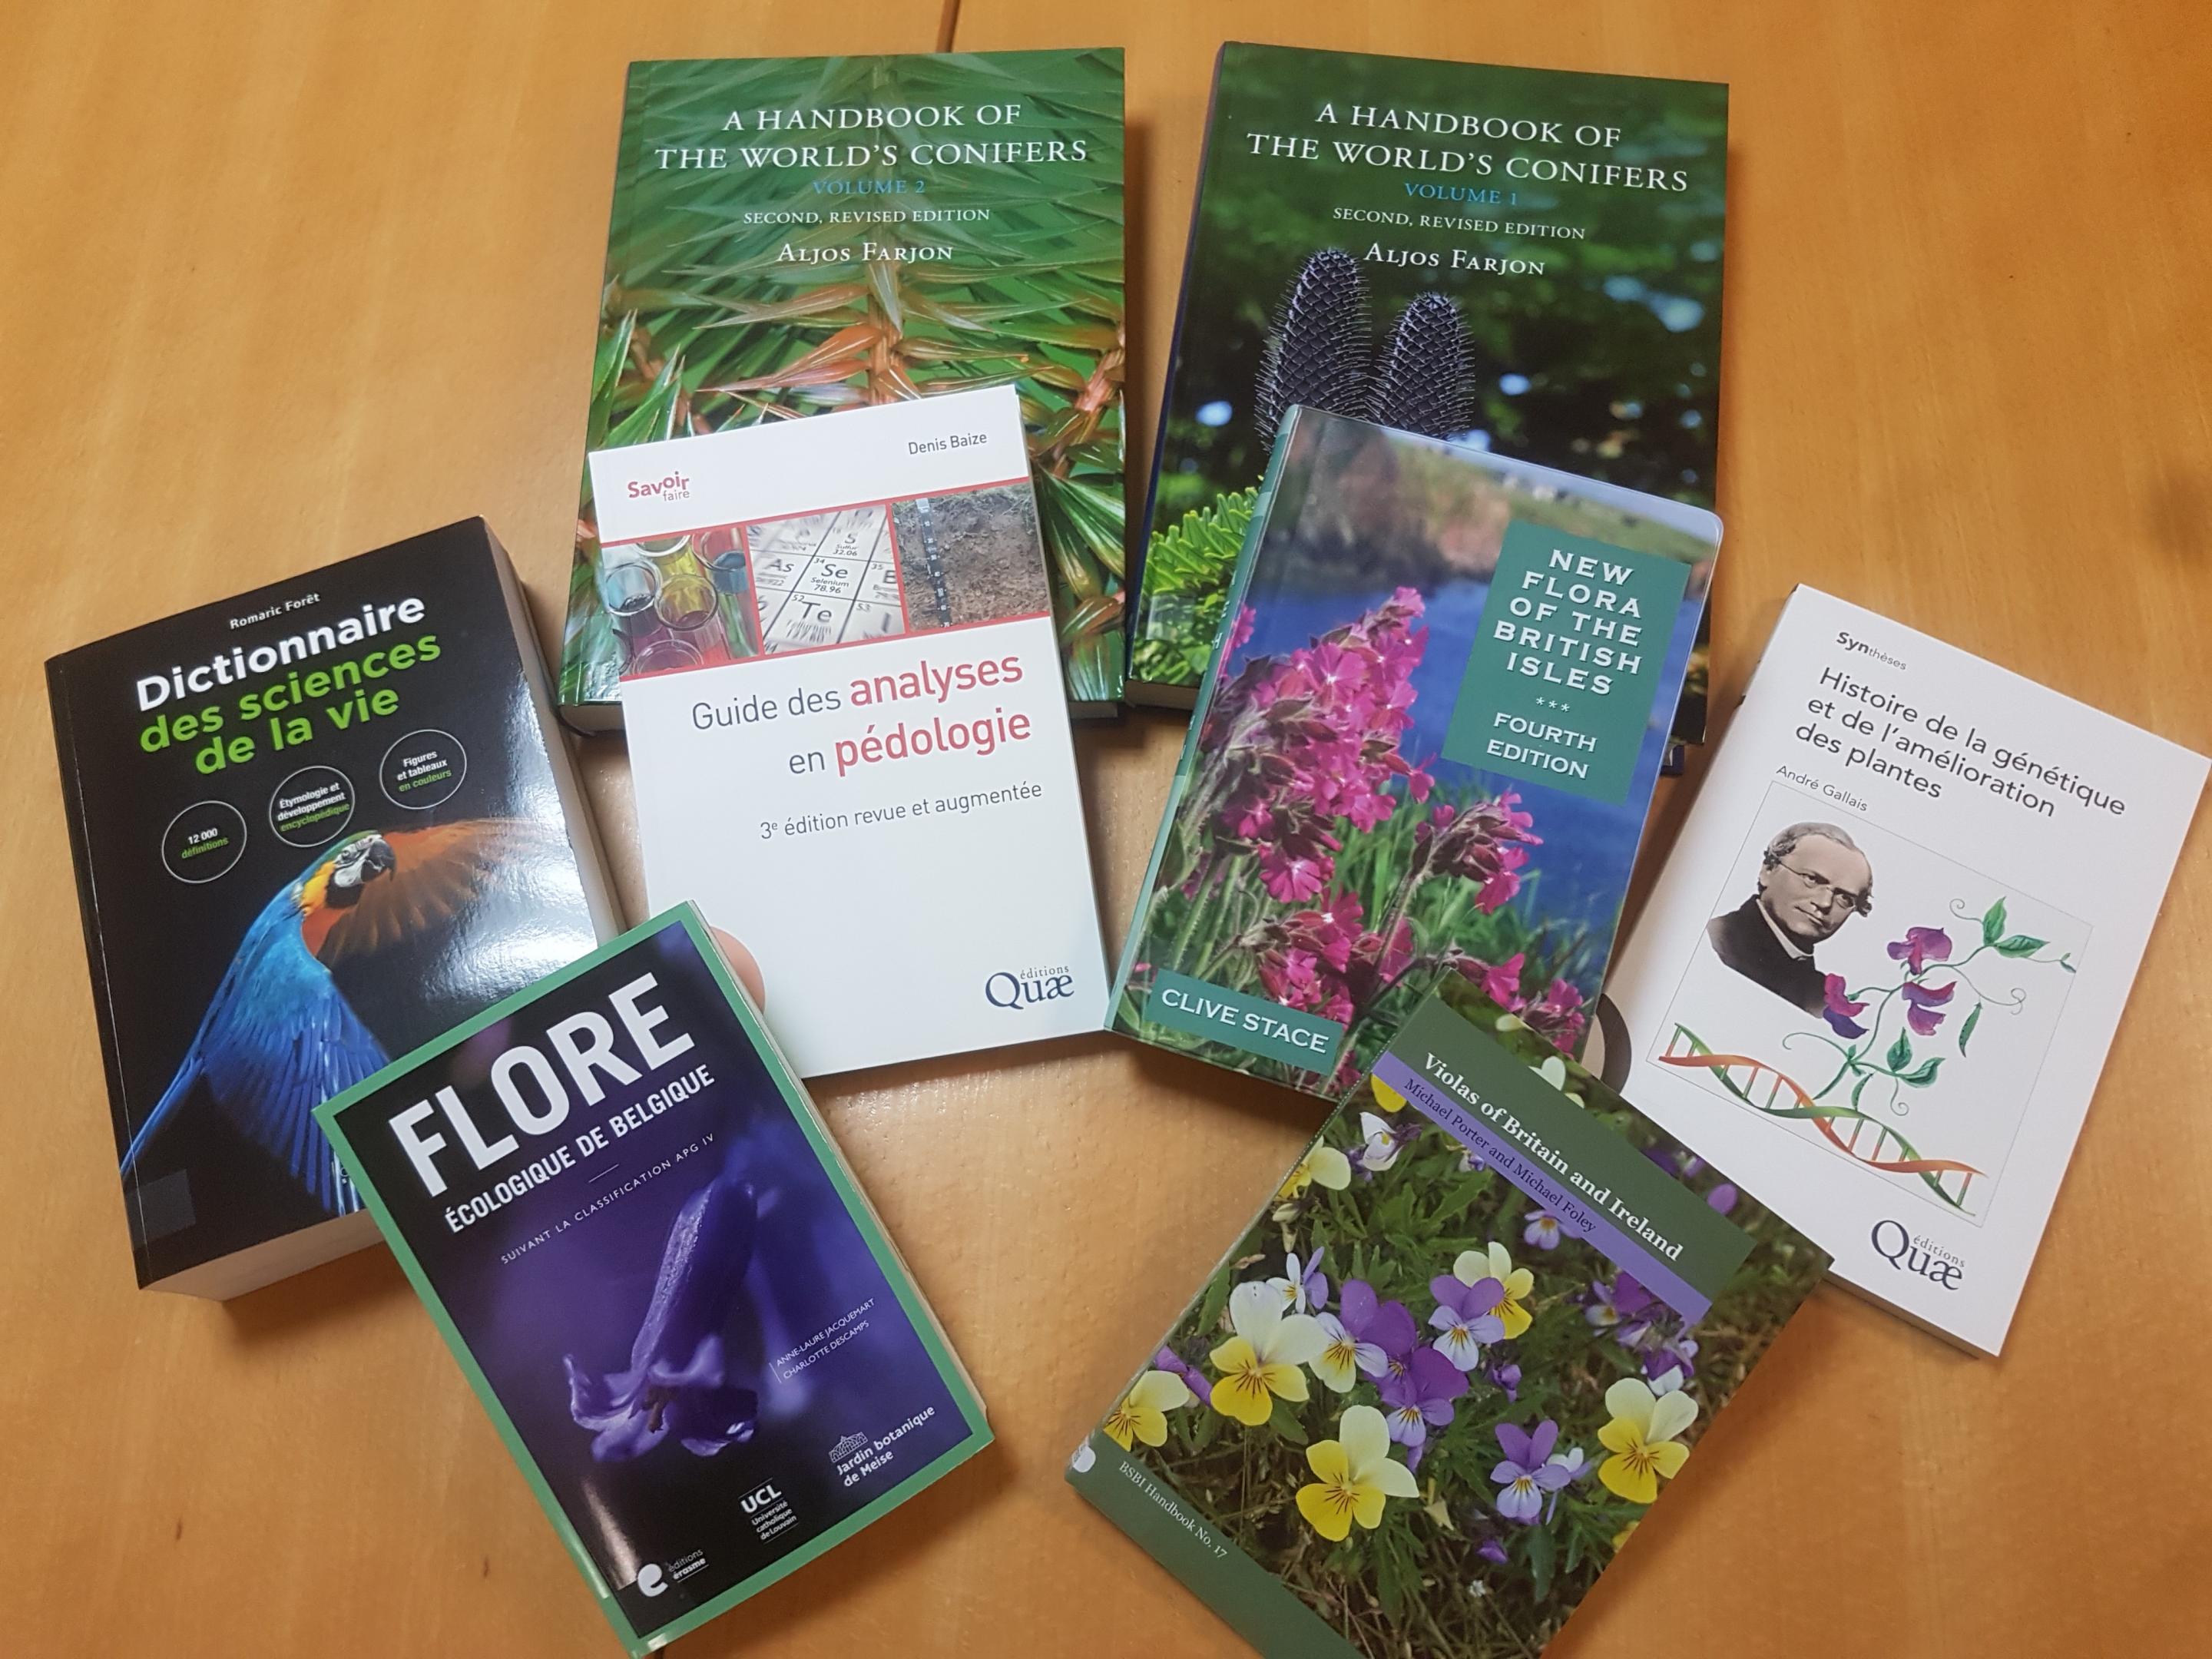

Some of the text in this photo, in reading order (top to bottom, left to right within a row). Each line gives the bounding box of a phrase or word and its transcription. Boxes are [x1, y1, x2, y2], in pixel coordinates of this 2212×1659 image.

[722, 104, 1021, 131] A HANDBOOK OF
[1316, 103, 1621, 147] A HANDBOOK OF
[655, 147, 727, 170] THE
[911, 140, 1087, 165] CONIFERS
[1247, 133, 1320, 161] THE
[1505, 157, 1688, 192] CONIFERS
[813, 180, 926, 197] VOLUME 2
[1405, 182, 1517, 206] VOLUME 1
[743, 209, 990, 224] SECOND, REVISED EDITION
[1333, 207, 1584, 240] SECOND, REVISED EDITION
[908, 432, 988, 455] Denis Baize
[627, 471, 690, 498] Savoir
[662, 488, 690, 502] faire
[764, 558, 795, 572] As
[811, 577, 849, 587] Selenium
[821, 564, 849, 578] Se
[1548, 549, 1634, 586] NEW
[813, 584, 841, 594] 78.96
[1522, 571, 1642, 618] FLORA
[229, 592, 321, 631] Romaric Forêt
[802, 601, 832, 622] Te
[1509, 596, 1642, 647] OF THE
[136, 597, 426, 712] Dictionnaire
[1493, 620, 1642, 675] BRITISH
[1506, 651, 1613, 696] ISLES
[139, 634, 442, 752] des sciences
[692, 655, 1023, 730] Guide des analyses
[194, 686, 399, 774] de la vie
[1493, 711, 1597, 753] FOURTH
[1807, 697, 1833, 718] et
[1841, 710, 1874, 737] de
[403, 750, 438, 767] Figures
[789, 707, 1031, 777] en pédologie
[1485, 738, 1589, 780] EDITION
[1819, 667, 2126, 816] Histoire de la génétique
[396, 759, 448, 781] et tableaux
[1795, 723, 1942, 799] des plantes
[279, 782, 340, 810] Étymologie et
[399, 769, 452, 793] en couleurs
[1775, 765, 1869, 812] André Gallais
[277, 792, 346, 822] développement
[280, 803, 350, 833] encyclopédique
[784, 813, 849, 836] édition
[854, 804, 907, 826] revue
[911, 799, 930, 817] et
[935, 780, 1042, 815] augmentée
[181, 836, 229, 859] définitions
[187, 828, 218, 844] 12 000
[1020, 963, 1070, 980] éditions
[1161, 988, 1330, 1055] CLIVE STACE
[387, 972, 696, 1198] FLORE
[444, 1064, 716, 1233] ÉCOLOGIQUE DE BELGIQUE
[1404, 1078, 1597, 1233] Michael Porter and Michael Foley
[1425, 1052, 1684, 1262] Violas of Britain and Ireland
[501, 1133, 716, 1265] SUIVANT LA CLASSIFICATION APG IV
[1913, 1235, 1965, 1267] éditions
[777, 1298, 875, 1366] ANNE-LAURE JACQUEMART
[783, 1320, 869, 1379] CHARLOTTE DESCAMPS
[836, 1405, 935, 1476] Jardin botanique
[844, 1450, 894, 1487] de Meise
[740, 1485, 782, 1514] UCL
[751, 1501, 788, 1525] Université
[1119, 1461, 1227, 1559] BSBI Handbook No. 17
[757, 1508, 793, 1533] catholique
[760, 1515, 796, 1540] de Louvain
[668, 1548, 704, 1572] éditions
[674, 1558, 706, 1580] érasme
